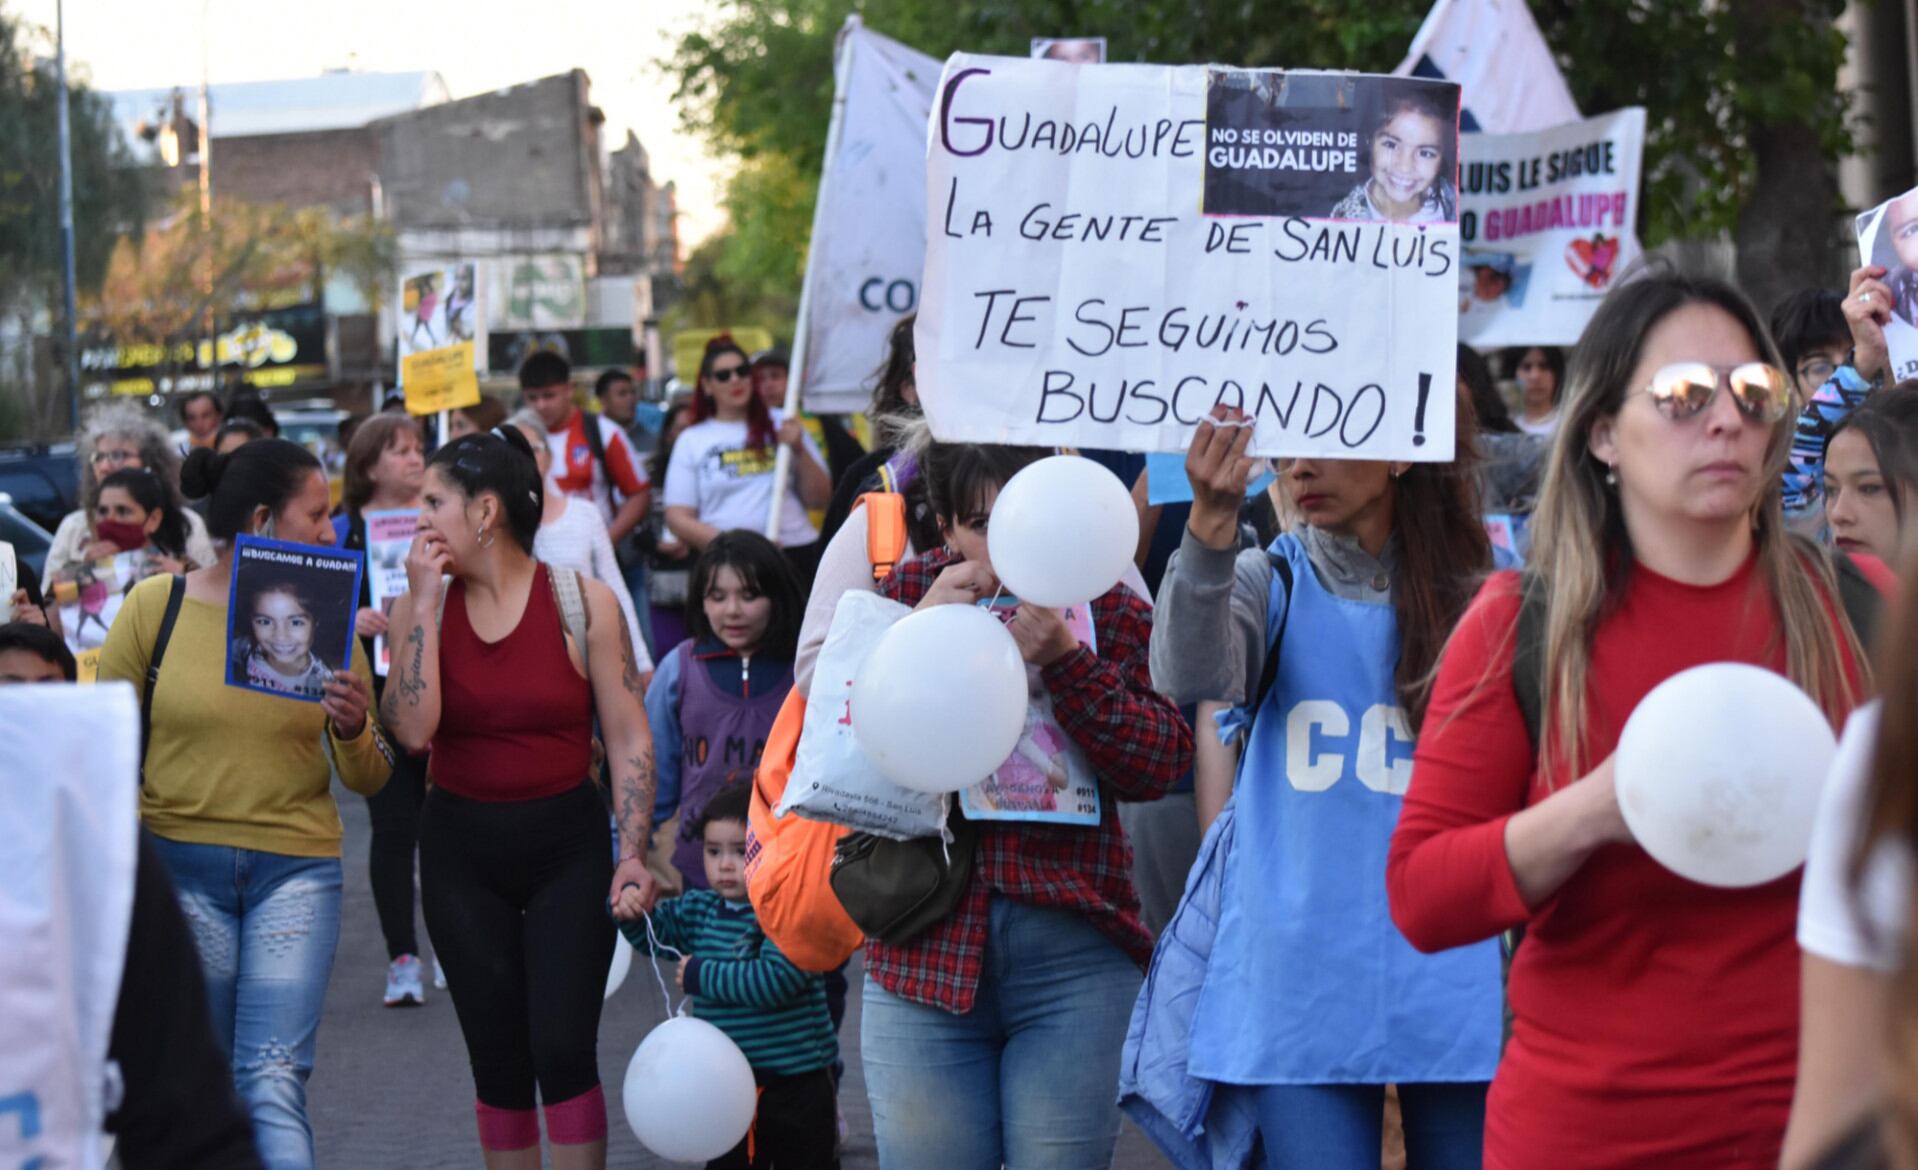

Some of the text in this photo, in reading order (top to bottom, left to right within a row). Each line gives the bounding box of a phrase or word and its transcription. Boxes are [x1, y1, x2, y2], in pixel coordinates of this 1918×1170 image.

[941, 68, 1206, 158] GUADALUPE
[1211, 128, 1358, 148] NO SE OLVIDEN DE
[1208, 146, 1358, 173] GUADALUPE
[1517, 157, 1541, 191] LE
[1546, 140, 1615, 184] SIGUE
[945, 176, 993, 239] LA
[1019, 202, 1179, 243] GENTE
[1204, 221, 1264, 254] DE
[1274, 217, 1361, 264] SAN
[1483, 191, 1628, 242] GUADALUPE
[974, 289, 1051, 350] TE
